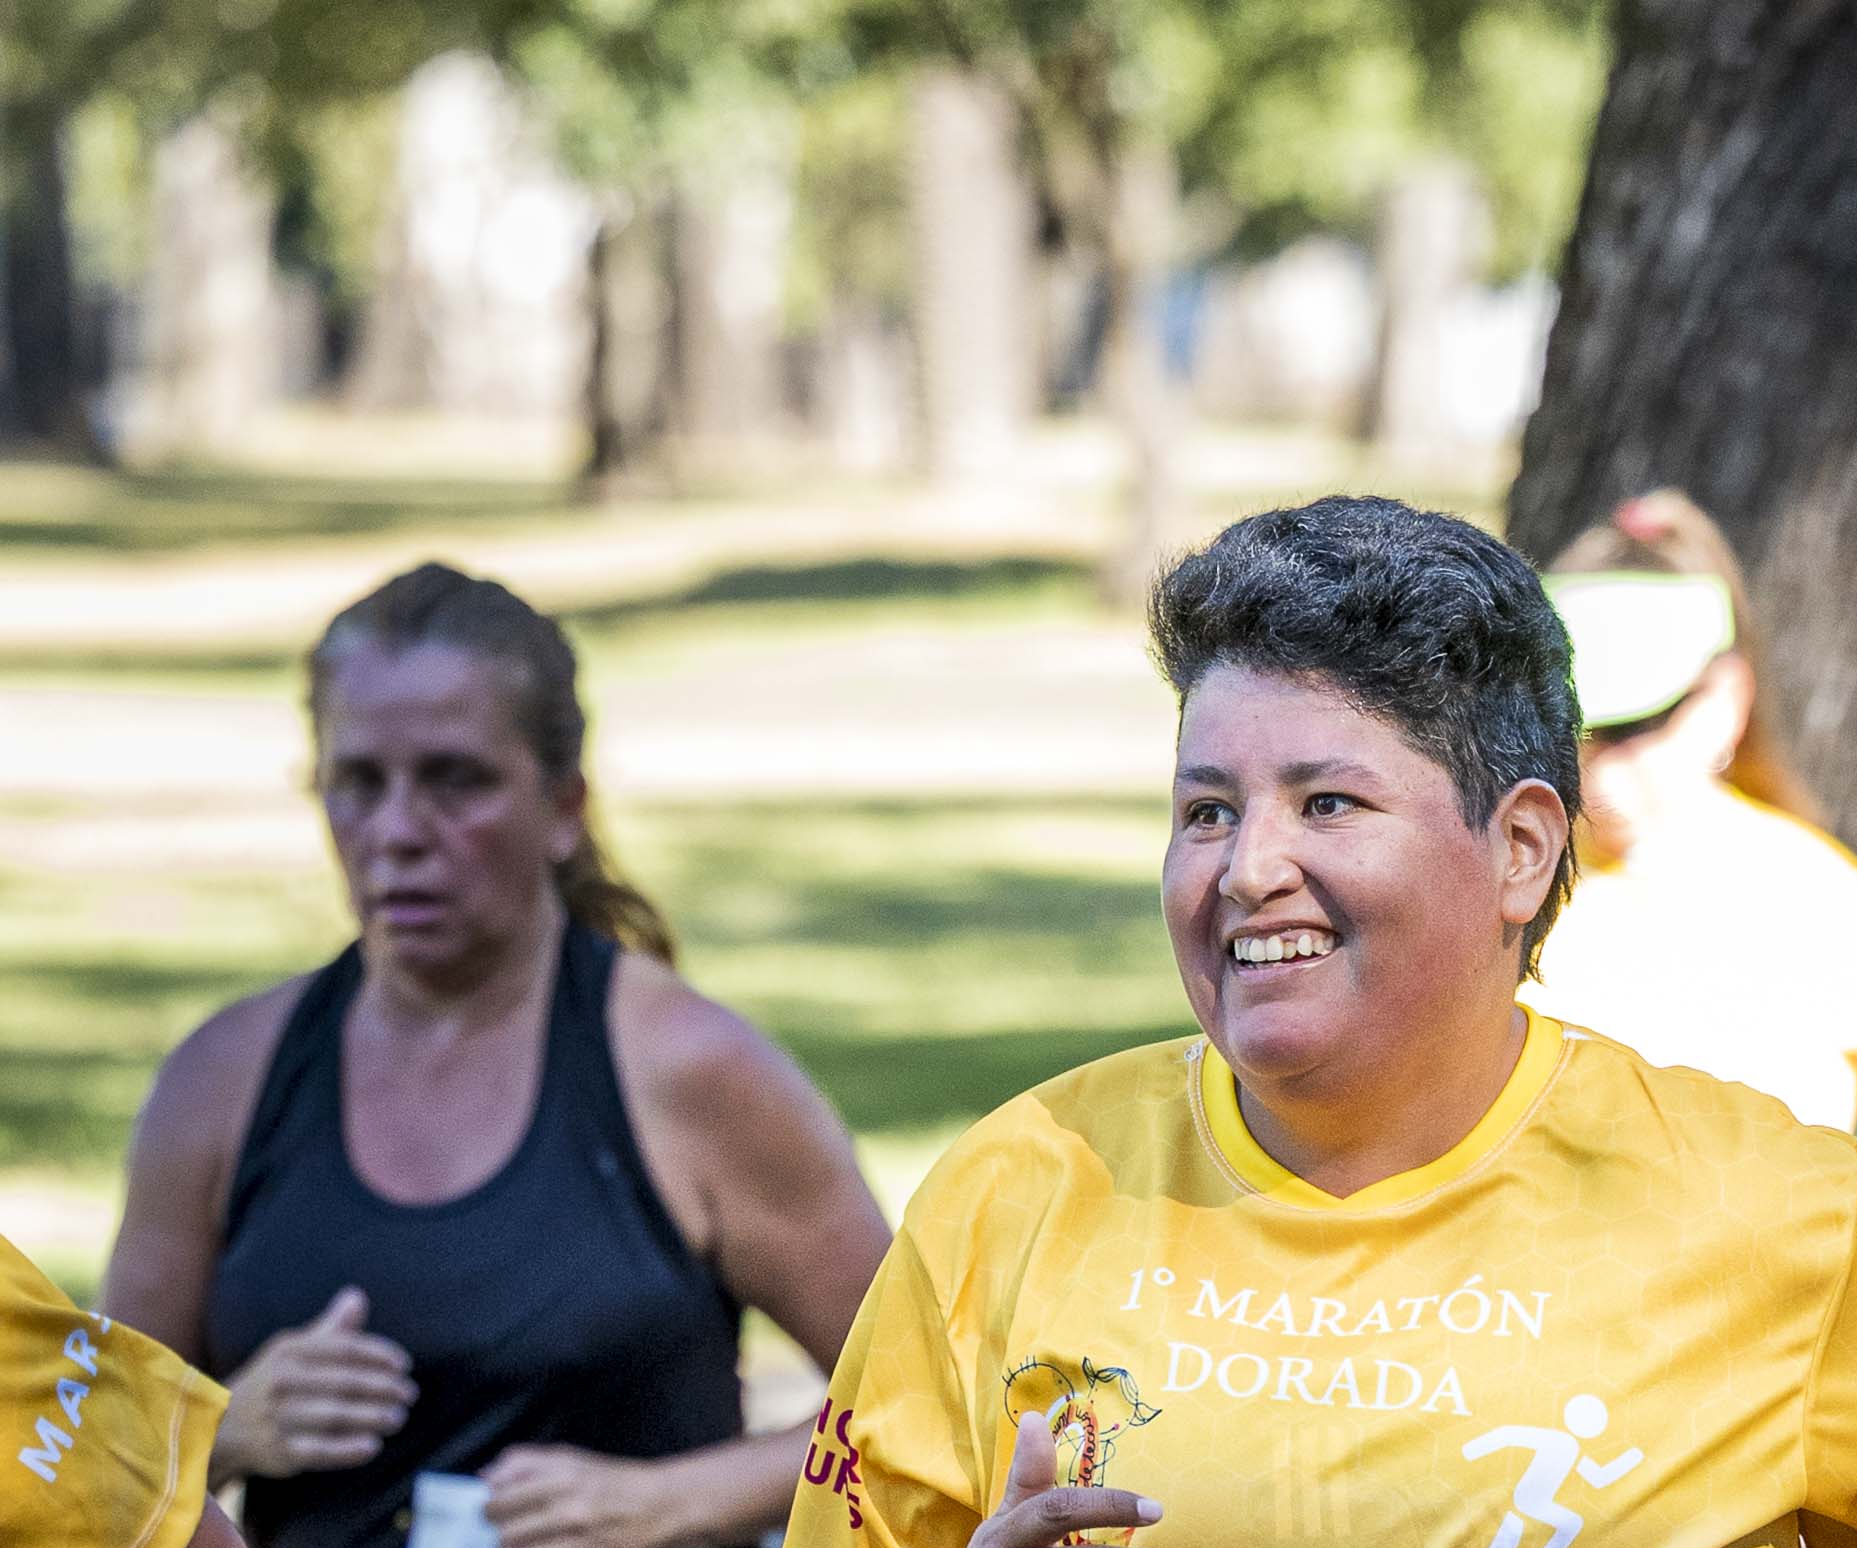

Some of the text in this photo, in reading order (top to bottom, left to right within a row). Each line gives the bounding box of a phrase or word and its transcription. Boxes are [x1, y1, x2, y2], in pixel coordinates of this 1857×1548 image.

[1187, 1274, 1551, 1339] MARATÓN
[18, 1312, 112, 1483] MAR
[1161, 1342, 1472, 1416] DORADA
